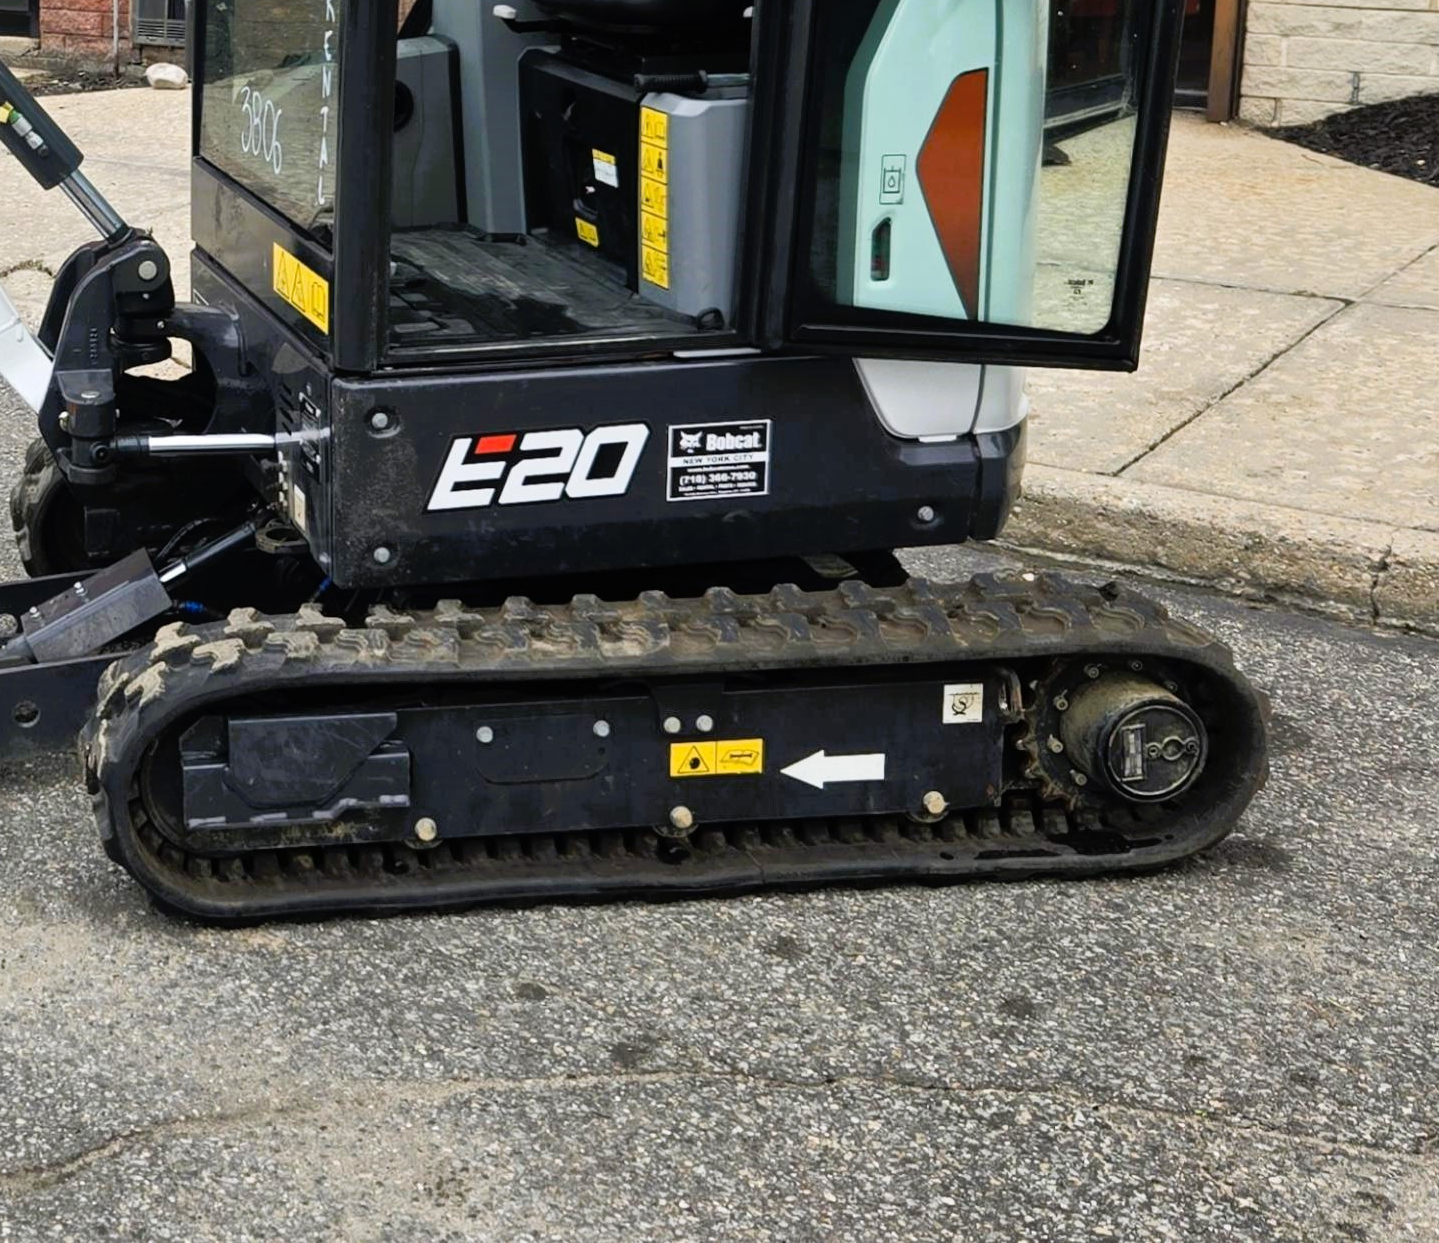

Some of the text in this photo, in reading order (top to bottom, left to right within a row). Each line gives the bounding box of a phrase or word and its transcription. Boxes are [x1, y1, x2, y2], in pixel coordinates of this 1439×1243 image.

[240, 85, 283, 175] 3806
[426, 422, 651, 512] E20
[683, 457, 703, 465] NEW
[705, 431, 762, 451] Bobcat
